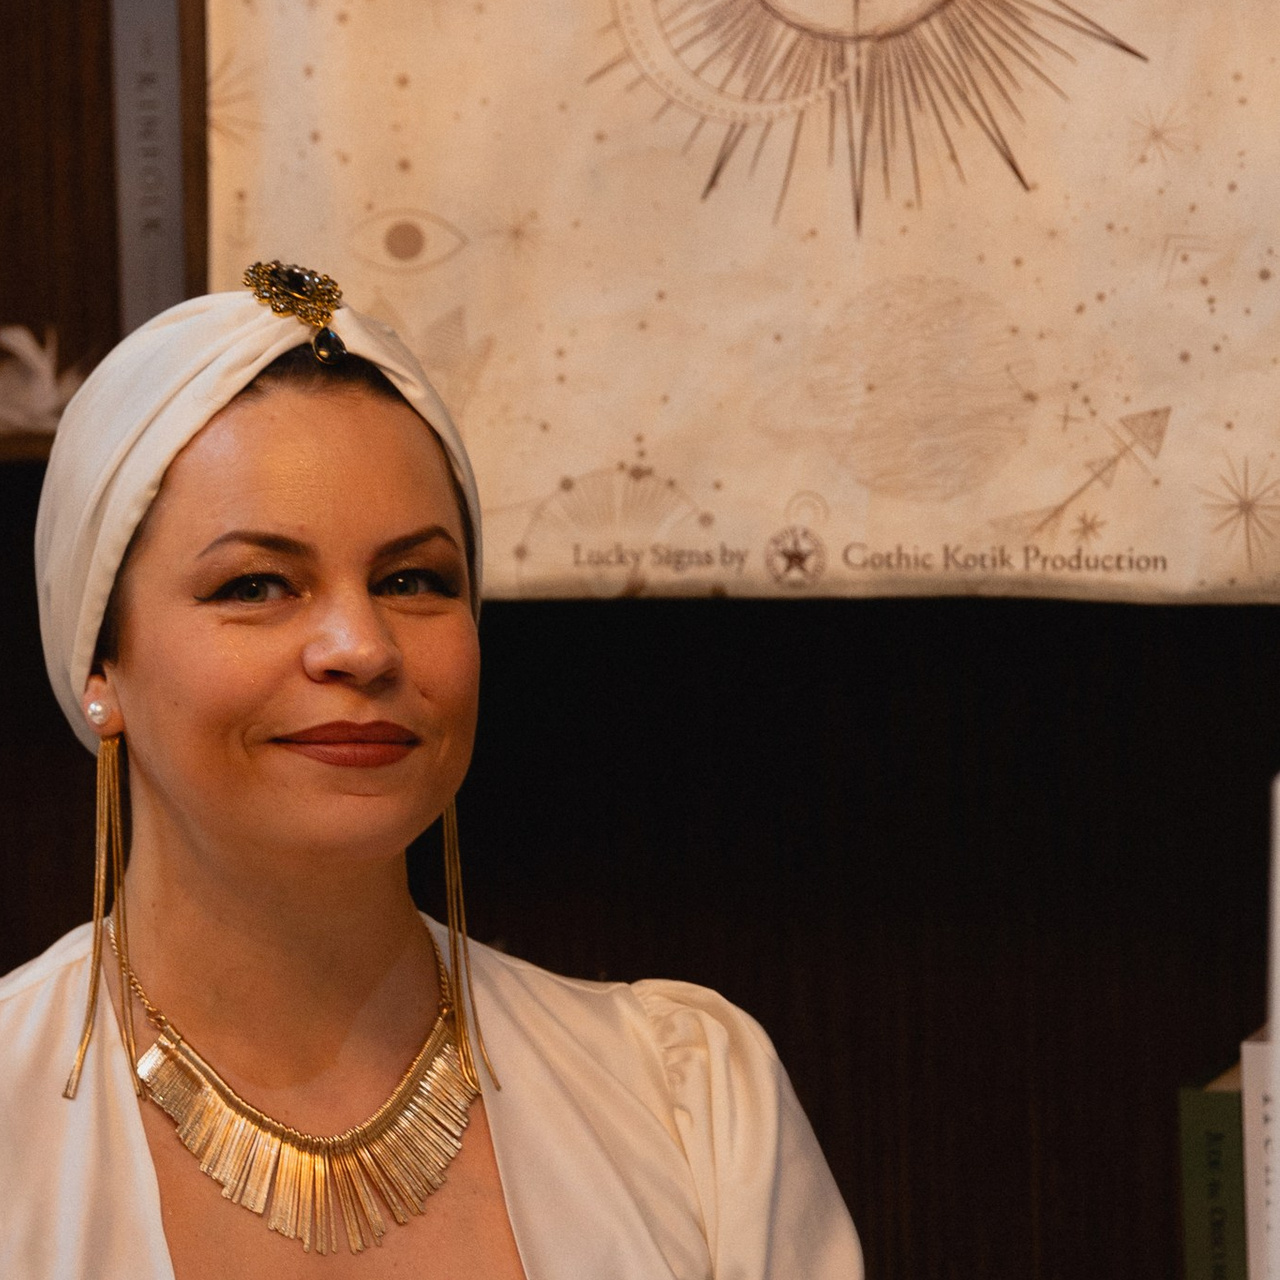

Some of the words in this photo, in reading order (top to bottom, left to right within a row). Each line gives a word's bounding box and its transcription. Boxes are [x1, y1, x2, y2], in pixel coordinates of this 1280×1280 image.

[135, 72, 163, 238] KINFOLK
[572, 543, 643, 571] Lucky
[650, 543, 715, 572] Signs
[720, 541, 750, 573] by
[841, 542, 933, 569] Gothic
[942, 544, 1015, 570] Kotik
[1023, 544, 1167, 571] Production
